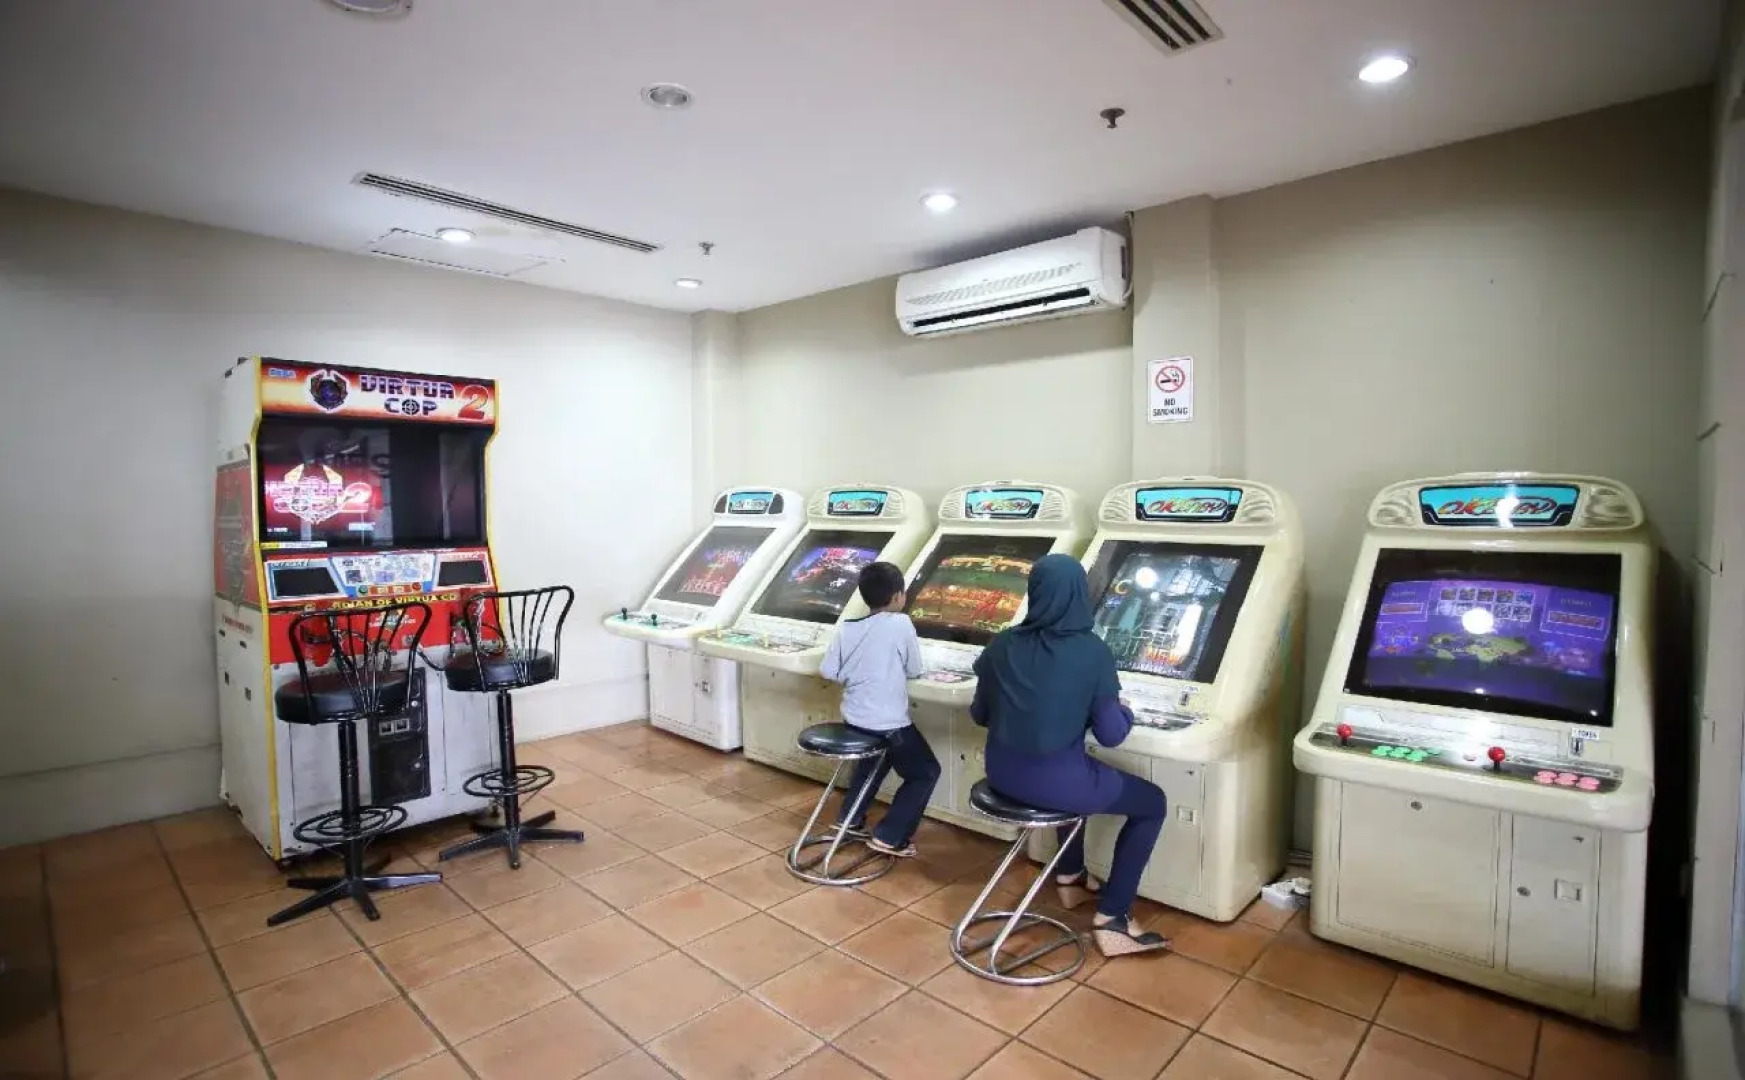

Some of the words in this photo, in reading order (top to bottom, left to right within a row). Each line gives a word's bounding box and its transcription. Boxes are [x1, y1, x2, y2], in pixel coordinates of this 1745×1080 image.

[359, 374, 454, 399] VIRTUA
[384, 397, 437, 416] COP
[457, 384, 489, 420] 2
[1164, 398, 1175, 406] NO
[1153, 408, 1188, 416] SMOKING
